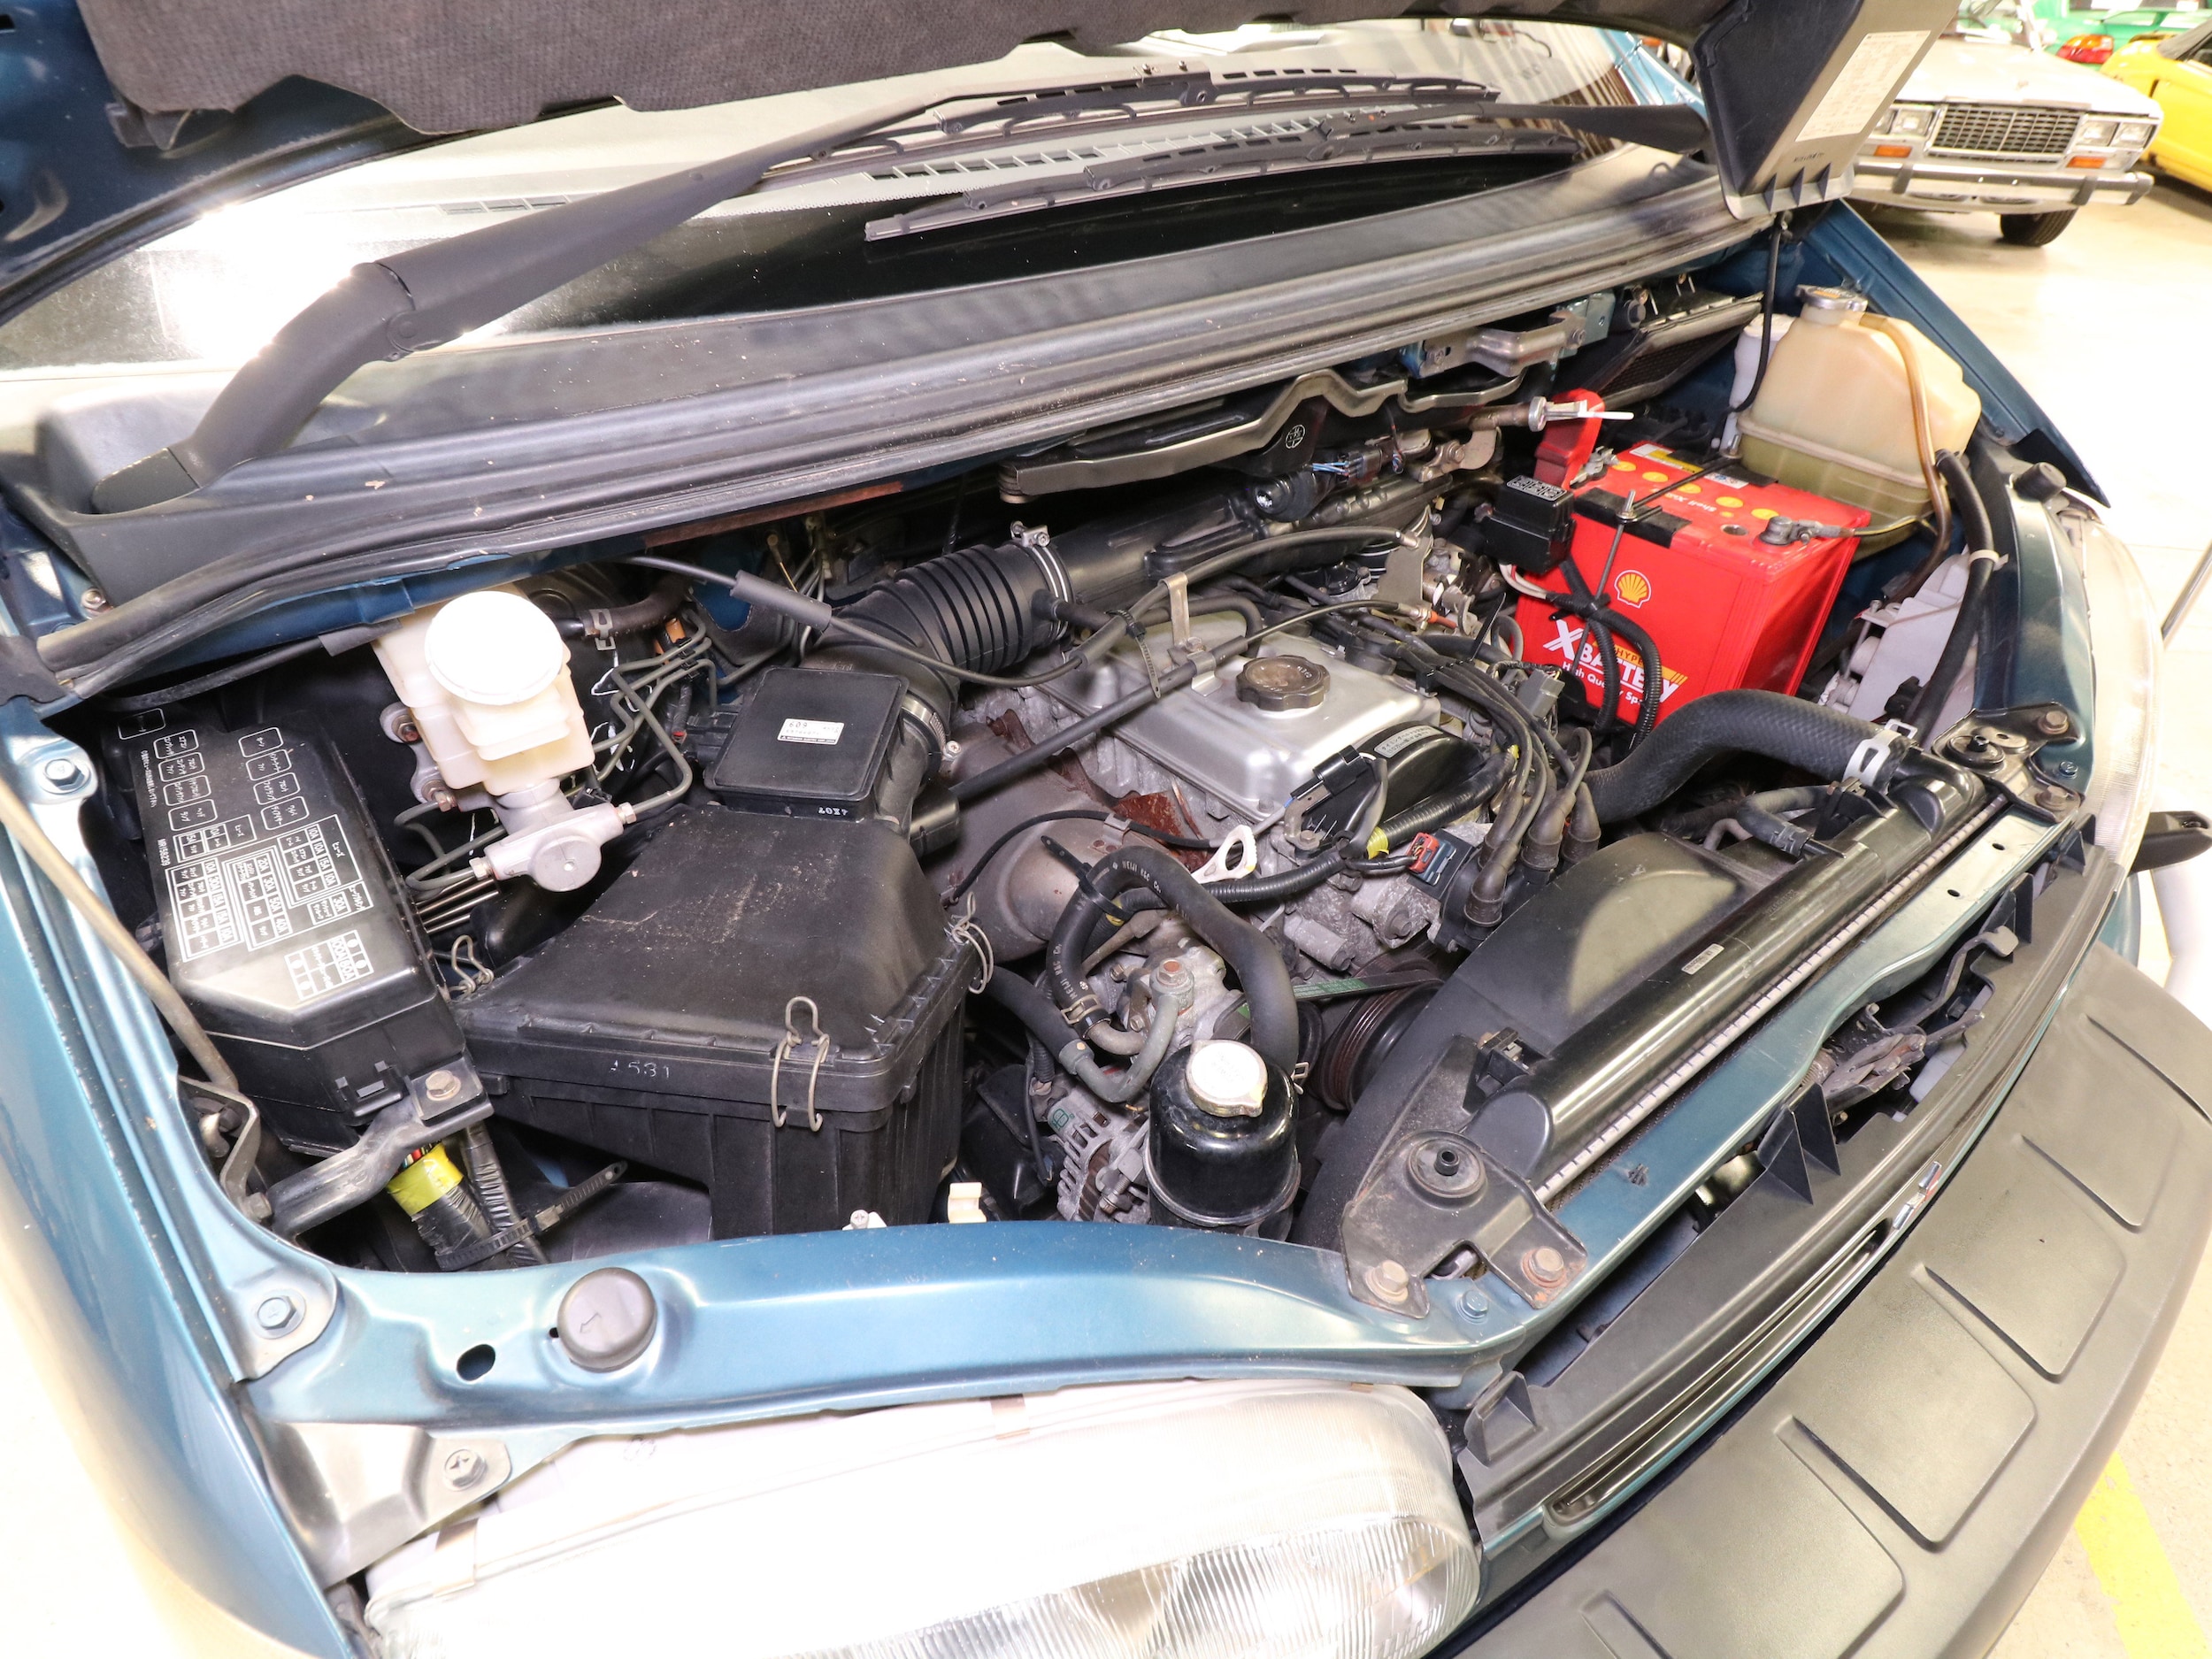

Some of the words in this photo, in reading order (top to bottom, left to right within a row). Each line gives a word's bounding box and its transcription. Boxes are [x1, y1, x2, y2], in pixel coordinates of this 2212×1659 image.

[1615, 647, 1644, 668] HYPE
[308, 826, 319, 839] 10A
[157, 838, 171, 866] MR158239
[313, 841, 325, 854] 10A
[331, 841, 345, 857] ヒューズ
[204, 861, 216, 873] 10A
[257, 857, 269, 872] 20A
[319, 856, 332, 870] 15A
[208, 876, 220, 890] 30A
[263, 877, 275, 891] 30A
[324, 872, 338, 886] 10A
[211, 893, 224, 906] 15A
[268, 896, 281, 912] 50A
[332, 895, 346, 911] 30A
[215, 910, 228, 924] 15A
[275, 918, 288, 933] 40A
[330, 937, 346, 959] 100A
